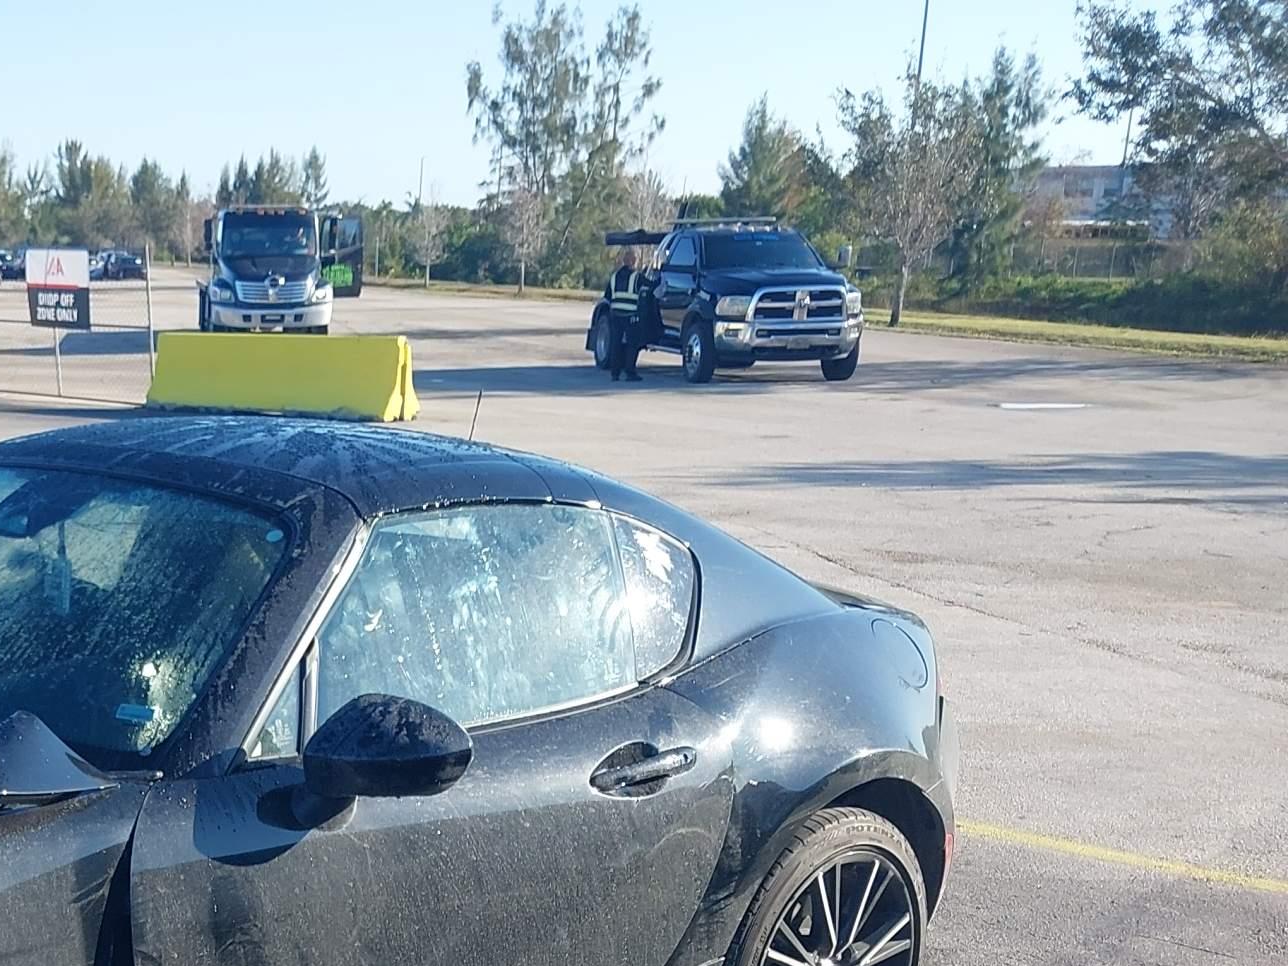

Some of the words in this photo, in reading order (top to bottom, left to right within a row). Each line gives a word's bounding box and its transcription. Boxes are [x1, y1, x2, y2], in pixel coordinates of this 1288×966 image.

[37, 292, 59, 306] DROP
[59, 293, 75, 307] OFF
[36, 307, 56, 321] ZONE
[56, 308, 78, 322] ONLY
